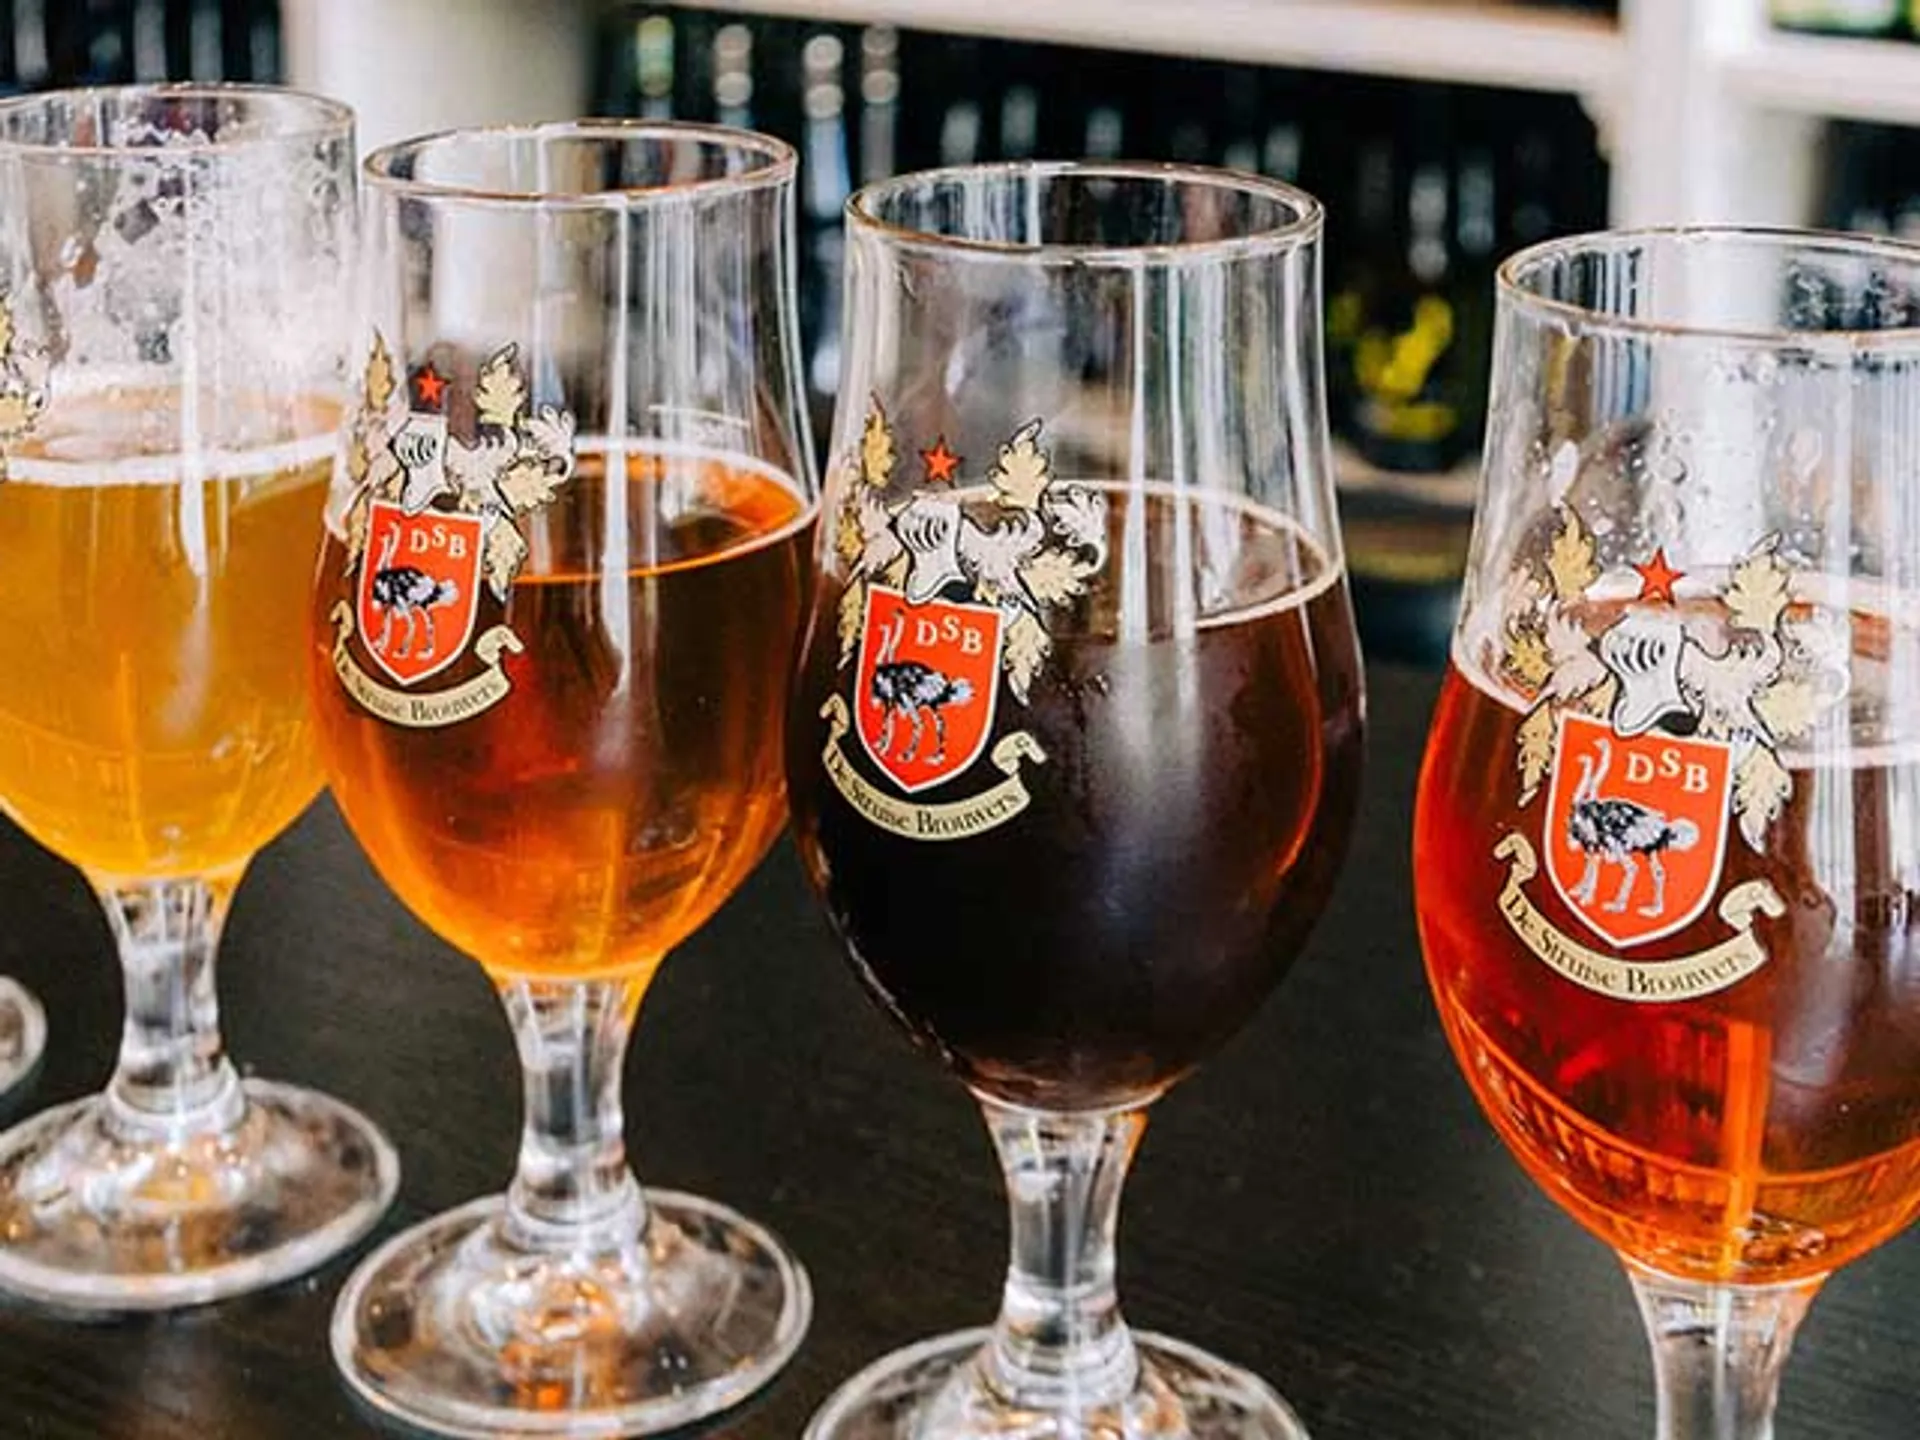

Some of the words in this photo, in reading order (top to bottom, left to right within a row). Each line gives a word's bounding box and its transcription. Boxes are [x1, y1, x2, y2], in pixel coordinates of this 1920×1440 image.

[409, 523, 467, 558] DSB
[916, 615, 983, 654] DSB
[1626, 747, 1710, 793] DSB
[917, 793, 1019, 834] Brouwers
[1508, 894, 1534, 930] De
[1540, 930, 1616, 989] Struise
[1626, 950, 1752, 996] Brouwers
